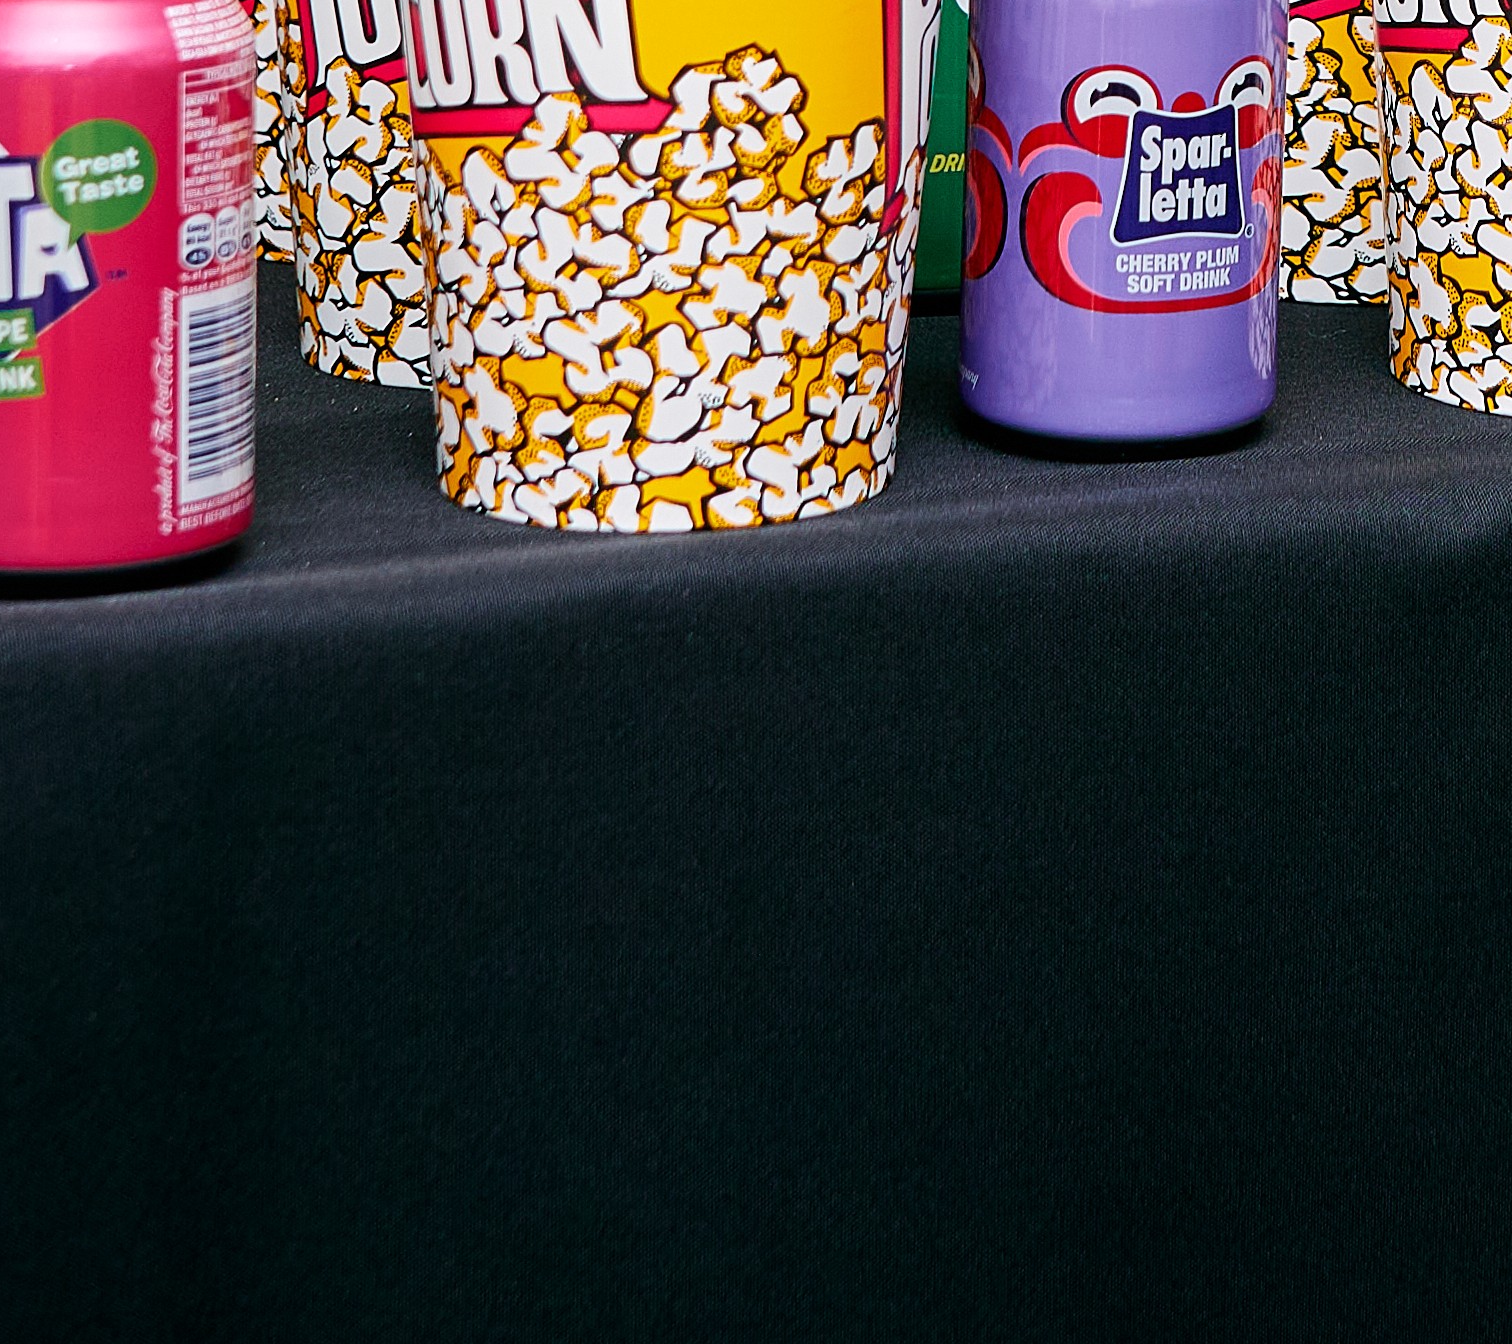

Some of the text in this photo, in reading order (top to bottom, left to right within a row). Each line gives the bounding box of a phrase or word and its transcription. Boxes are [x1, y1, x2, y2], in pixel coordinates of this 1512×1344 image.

[53, 146, 140, 181] Great
[929, 153, 965, 173] DRI
[60, 173, 145, 206] Taste
[1138, 172, 1228, 223] letta
[1116, 244, 1240, 273] CHERRY PLUM
[1127, 267, 1231, 294] SOFT DRINK
